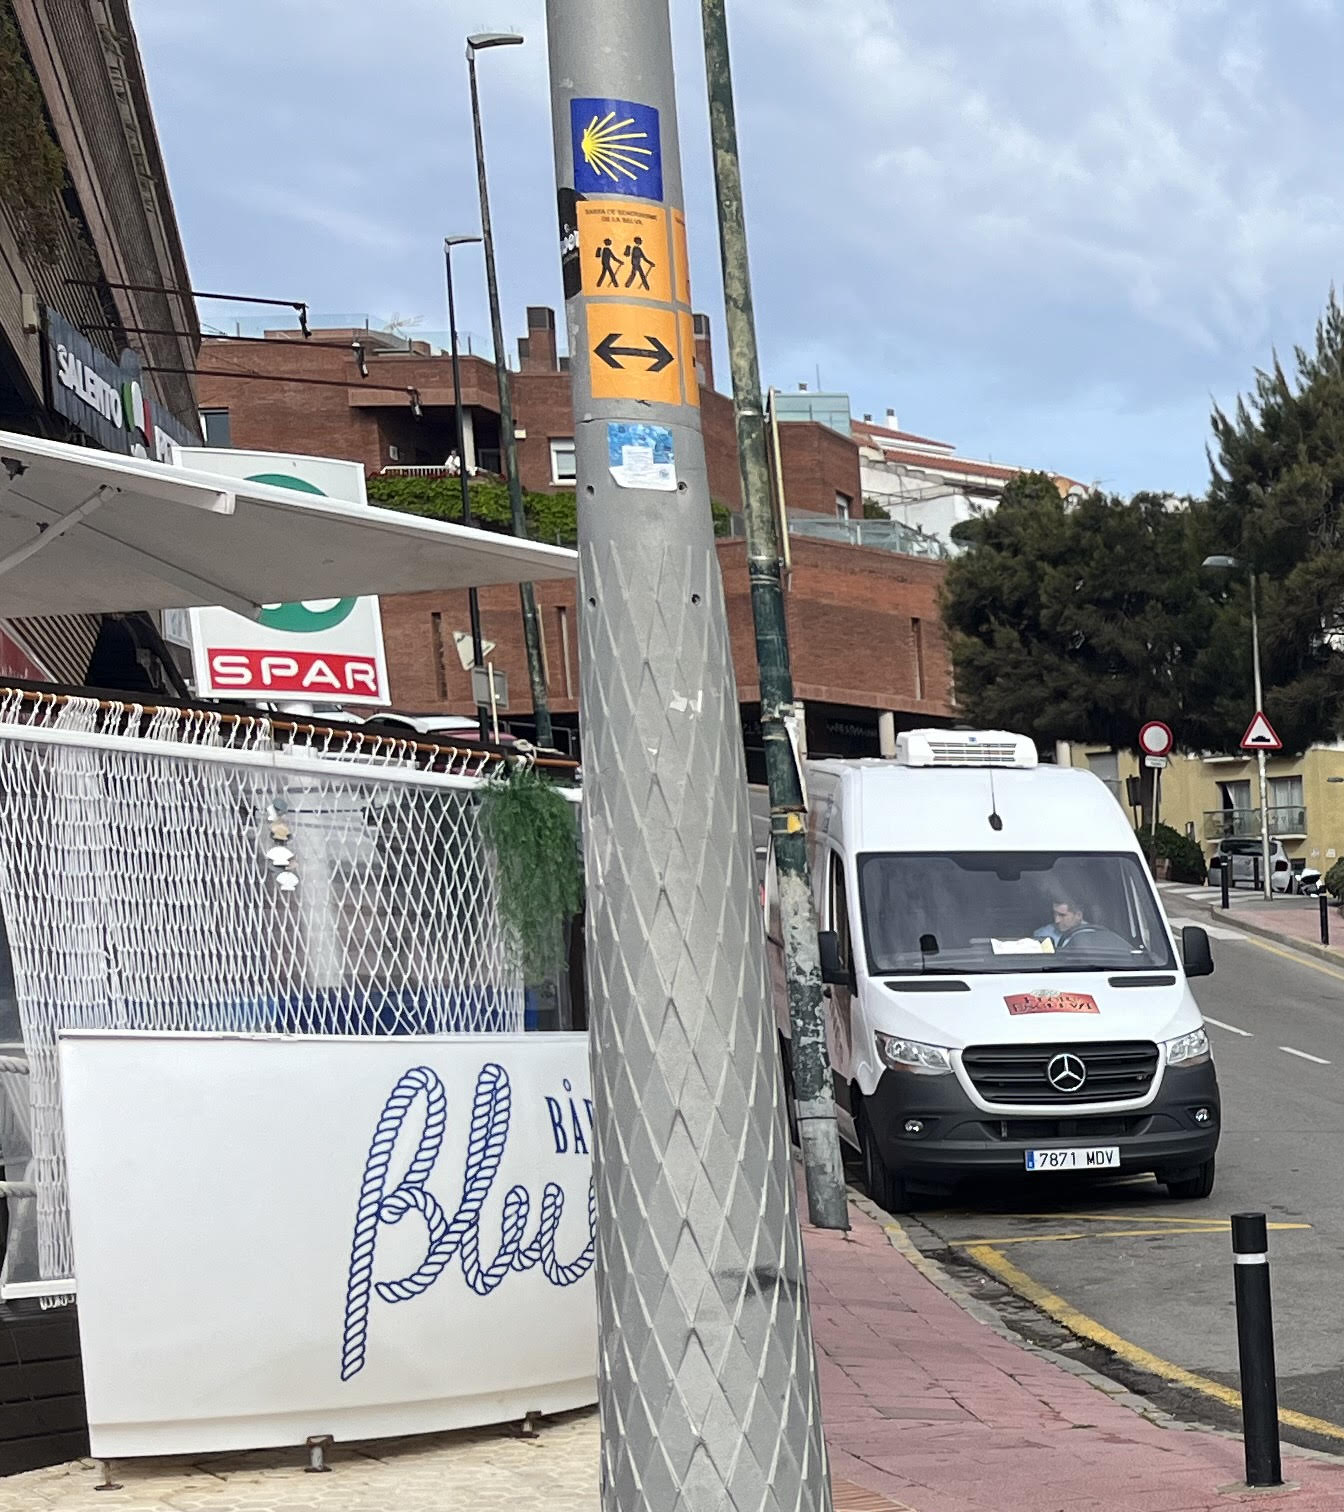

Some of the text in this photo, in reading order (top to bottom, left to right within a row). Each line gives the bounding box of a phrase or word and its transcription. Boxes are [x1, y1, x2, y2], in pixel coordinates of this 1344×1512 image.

[212, 655, 377, 692] SPAR
[1040, 1150, 1113, 1167] 7871 MDV
